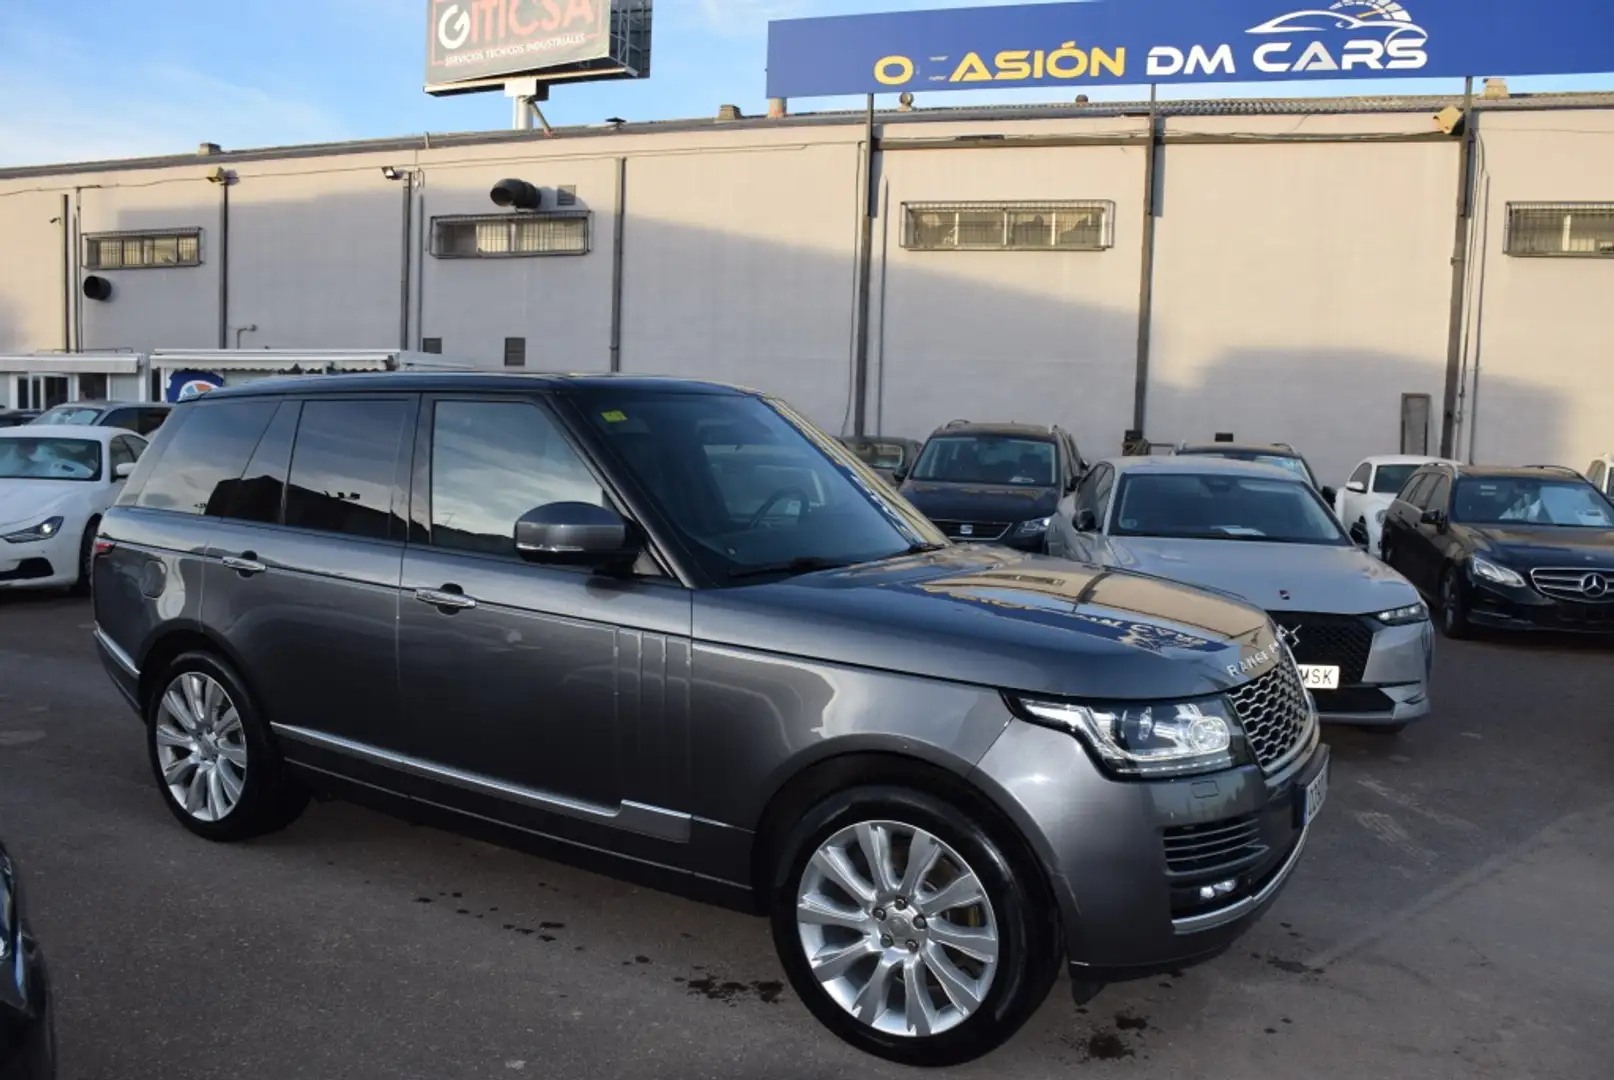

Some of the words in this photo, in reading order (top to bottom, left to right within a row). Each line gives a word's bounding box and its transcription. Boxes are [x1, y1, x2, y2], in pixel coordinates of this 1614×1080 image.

[873, 40, 1126, 85] OASIÓN
[1146, 44, 1236, 75] DM
[1252, 38, 1428, 72] CARS
